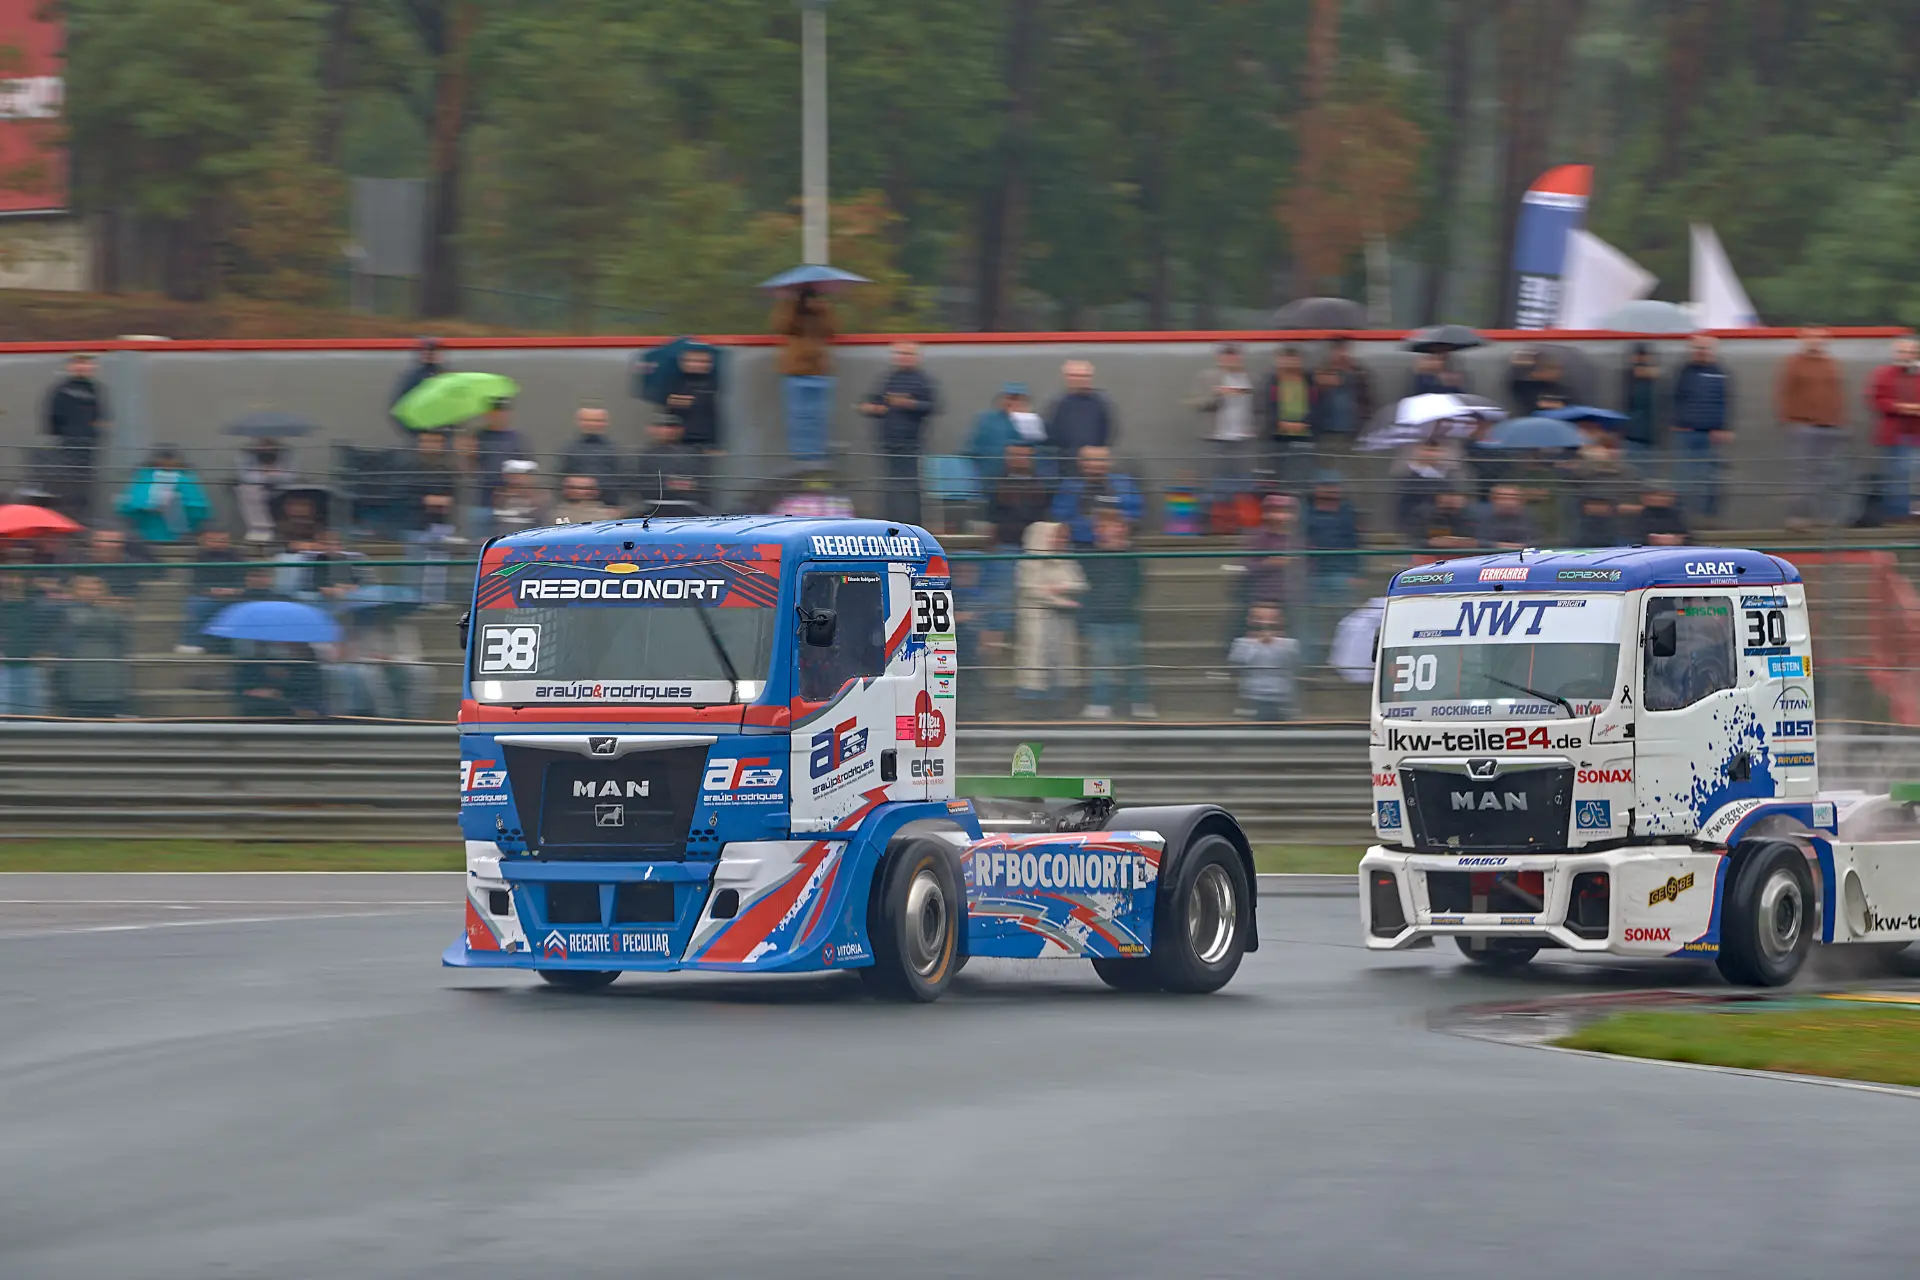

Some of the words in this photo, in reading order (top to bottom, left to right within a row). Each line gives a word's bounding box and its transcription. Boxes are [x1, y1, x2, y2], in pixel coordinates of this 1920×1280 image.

[811, 535, 921, 557] REBOCONORT
[1479, 568, 1529, 580] FERNFAHRER
[1557, 571, 1609, 579] COREXX
[1685, 561, 1735, 575] CARAT
[520, 579, 725, 600] REBOCONORT
[1556, 599, 1584, 607] WRIGHT
[915, 591, 951, 633] 38
[1456, 600, 1557, 637] NWT
[1745, 610, 1787, 647] 30
[484, 627, 538, 672] 38
[1393, 654, 1437, 693] 30
[1771, 661, 1800, 672] BILSTEIN
[535, 681, 692, 701] araújo&rodrigues
[1385, 706, 1418, 718] JOST
[1431, 704, 1492, 716] ROCKINGER
[1508, 704, 1557, 715] TRIDEC
[1575, 701, 1602, 715] HYVA
[1779, 700, 1813, 710] TITANX
[1772, 720, 1814, 737] JOST
[1388, 727, 1582, 751] lkw-teile24.de
[1577, 769, 1633, 784] SONAX
[573, 780, 650, 798] MAN
[1451, 791, 1528, 811] MAN
[569, 933, 611, 953] RECENTE
[622, 933, 670, 953] PECULIAR
[1624, 928, 1671, 942] SONAX
[836, 941, 863, 957] VITÓRIA
